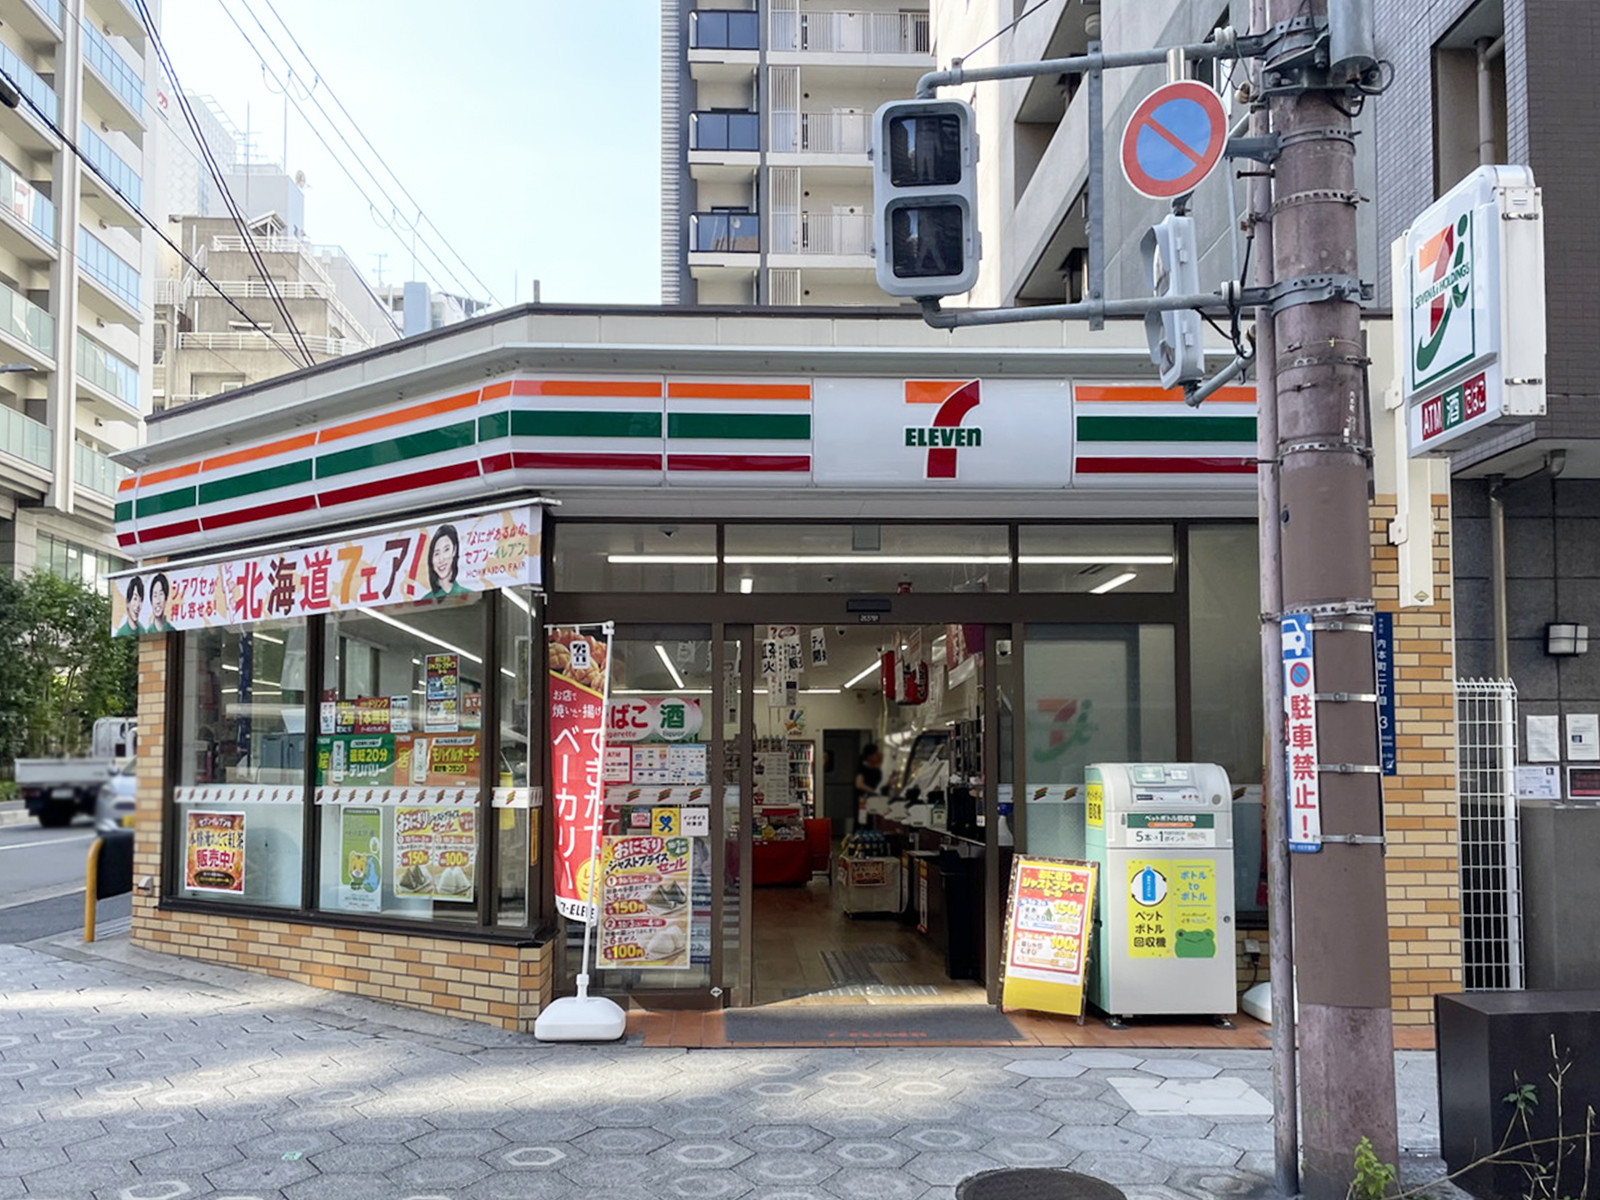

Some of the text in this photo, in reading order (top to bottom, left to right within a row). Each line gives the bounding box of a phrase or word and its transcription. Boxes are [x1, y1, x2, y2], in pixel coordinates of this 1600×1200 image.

[1445, 390, 1460, 428] 酒
[1423, 400, 1442, 436] ATM
[466, 560, 526, 577] HOKKAIDO FAIR
[172, 577, 217, 600] シアワセが
[171, 600, 217, 621] 押し寄せる!
[553, 690, 577, 702] お店で
[606, 703, 648, 729] ばこ
[660, 704, 684, 728] 酒
[1379, 716, 1388, 729] 3
[349, 763, 387, 777] デリバリー
[1291, 694, 1316, 839] 駐車禁止!
[553, 726, 580, 890] ベーカリー
[614, 838, 662, 859] おにぎり
[196, 849, 235, 869] 販売中!
[608, 853, 669, 871] ジャストプライス
[657, 858, 687, 872] セール
[1180, 871, 1207, 880] ボトル
[1188, 882, 1199, 890] to
[1181, 892, 1207, 901] ボトル
[1135, 911, 1163, 921] ペット
[1135, 924, 1164, 934] ボトル
[1134, 937, 1167, 948] 回収機
[612, 944, 644, 959] 100円
